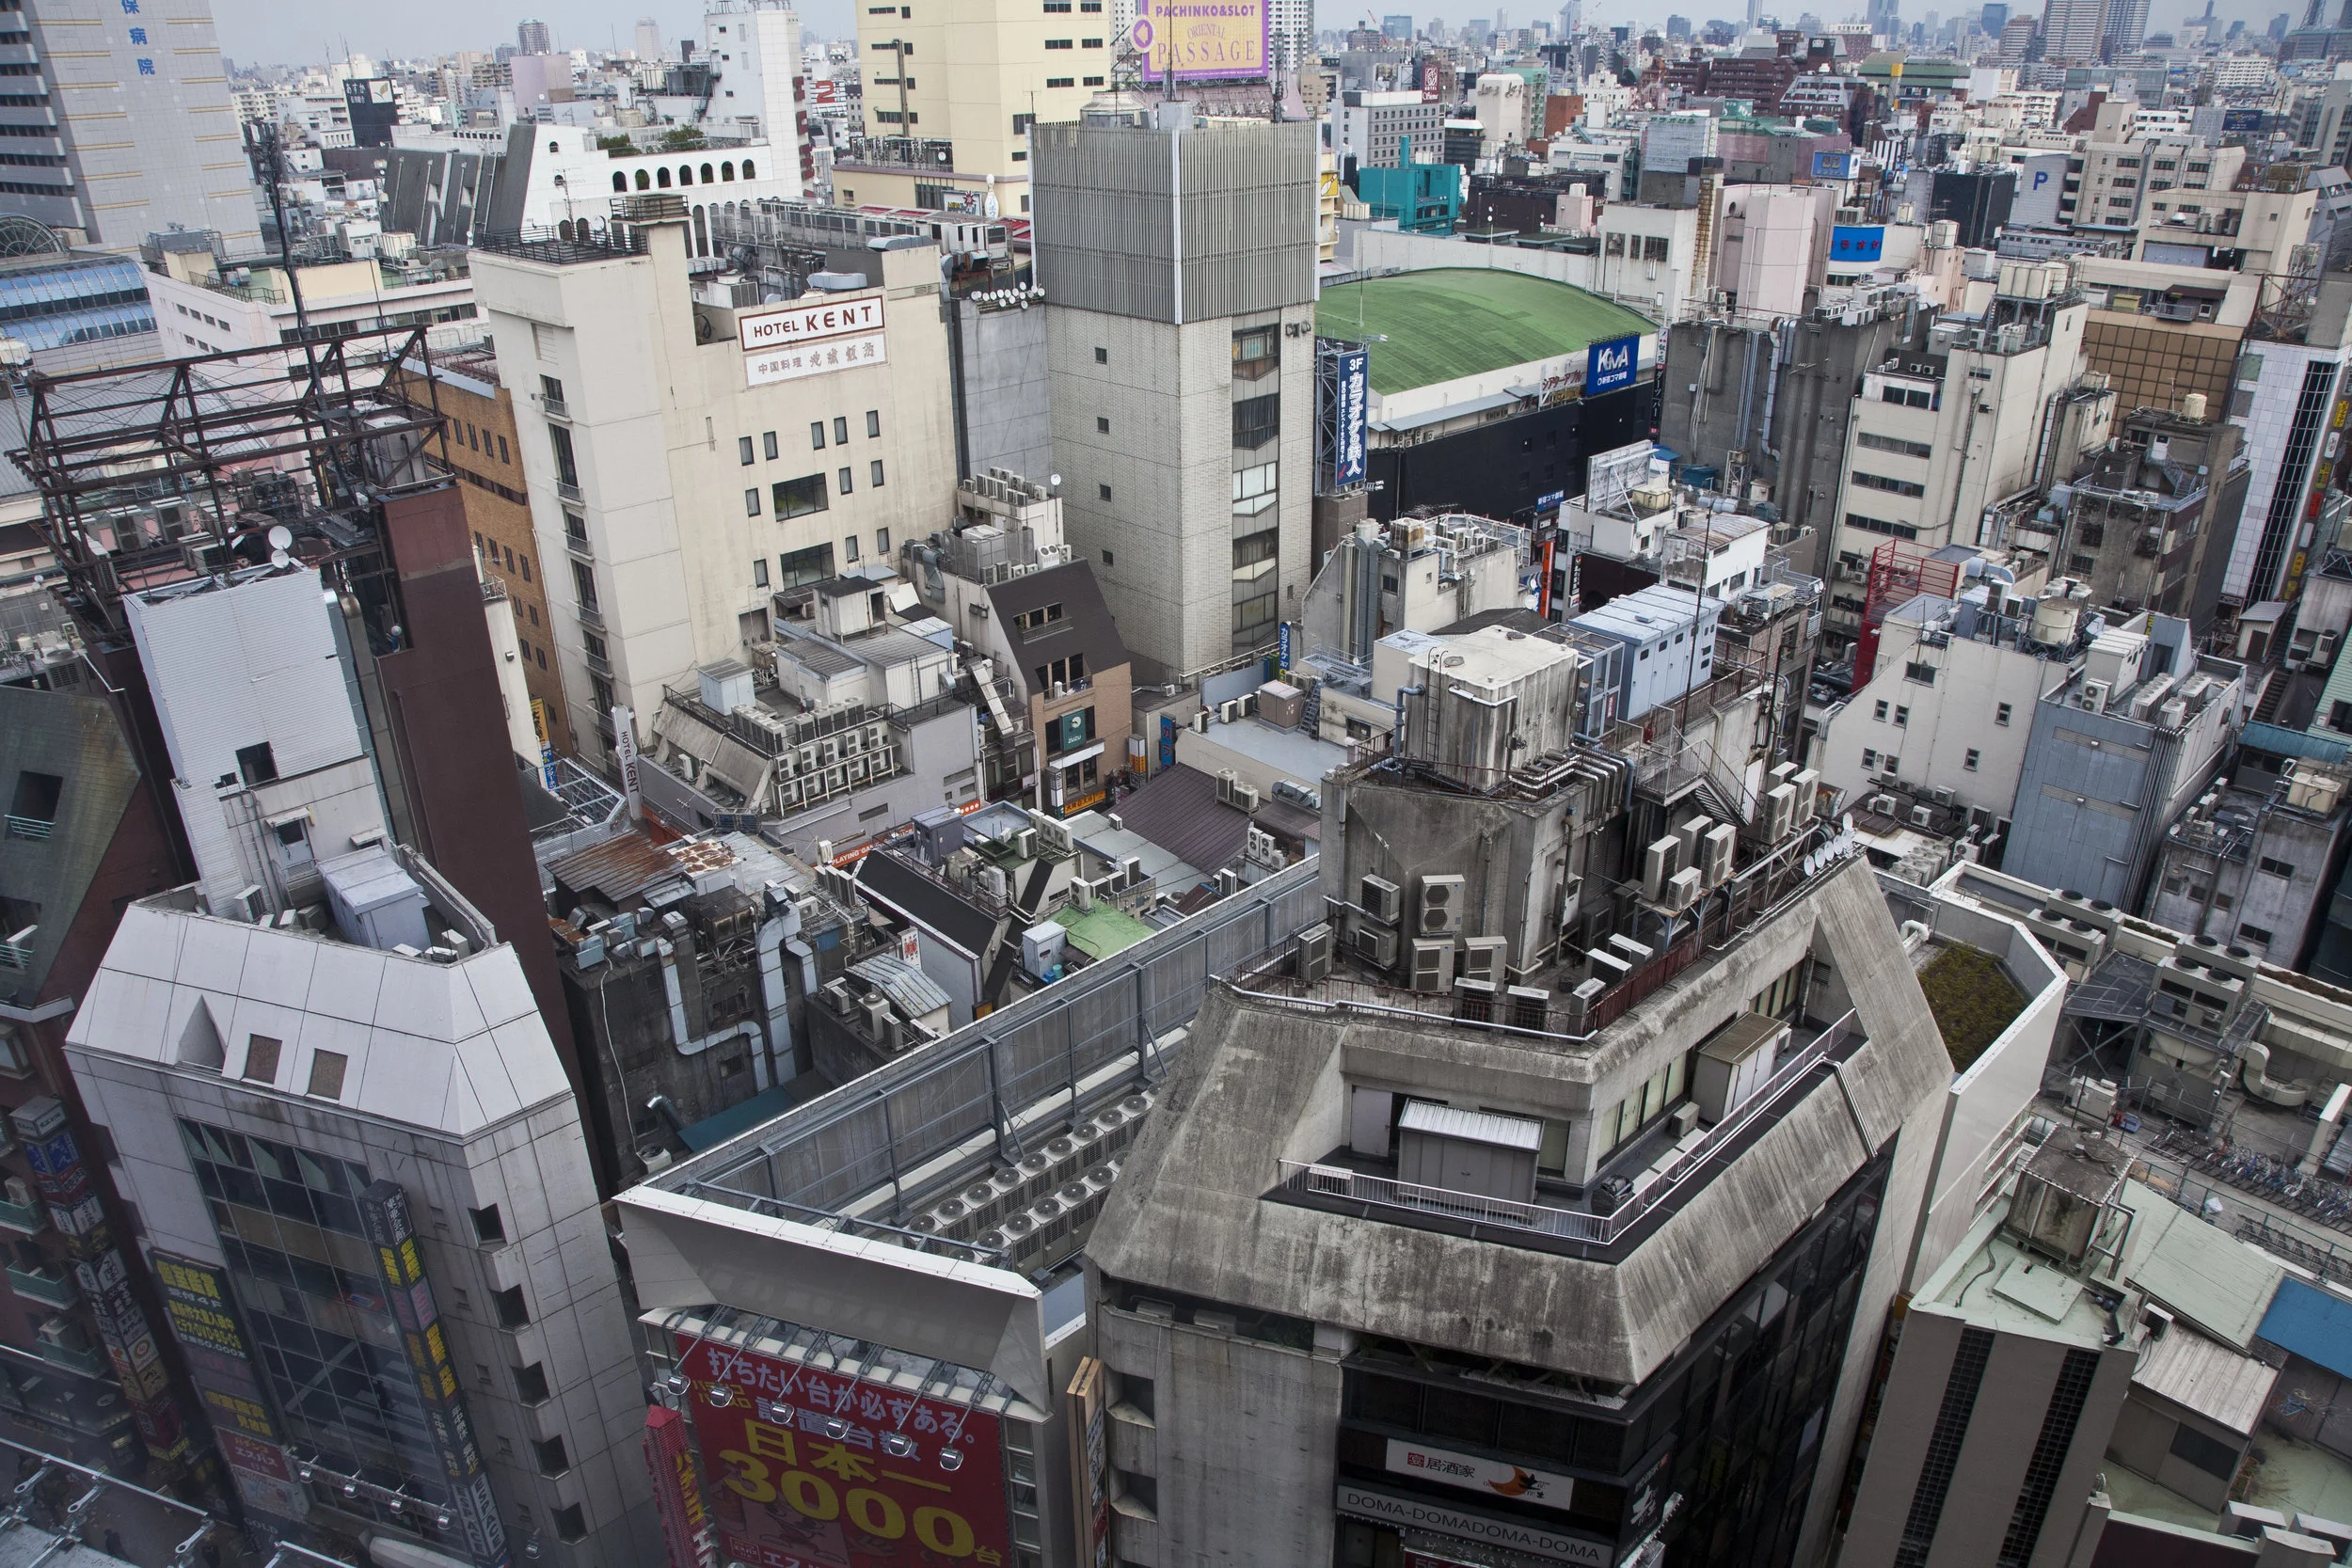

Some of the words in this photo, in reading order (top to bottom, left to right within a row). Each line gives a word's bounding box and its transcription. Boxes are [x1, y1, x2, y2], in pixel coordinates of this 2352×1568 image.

[1156, 6, 1255, 17] PACHINKO&SLOT
[1187, 24, 1226, 40] ORIENTAL
[1158, 41, 1255, 64] PASSAGE
[815, 80, 835, 104] 2
[2033, 171, 2049, 191] P
[754, 320, 800, 338] HOTEL
[806, 306, 871, 332] KENT
[758, 356, 803, 374] 中国料理
[1349, 357, 1363, 372] 3F
[1346, 372, 1364, 478] カラオケの鉄人
[621, 731, 632, 761] HOTEL
[626, 762, 640, 793] KENT
[707, 1346, 975, 1446] 打ちたい台が必ずある。
[744, 1418, 952, 1494] 日本一
[1425, 1457, 1476, 1480] 居酒家
[475, 1474, 505, 1551] ESPACE
[719, 1449, 975, 1558] 3000
[1347, 1493, 1600, 1561] DOMA-DOMADOMA-DOMA
